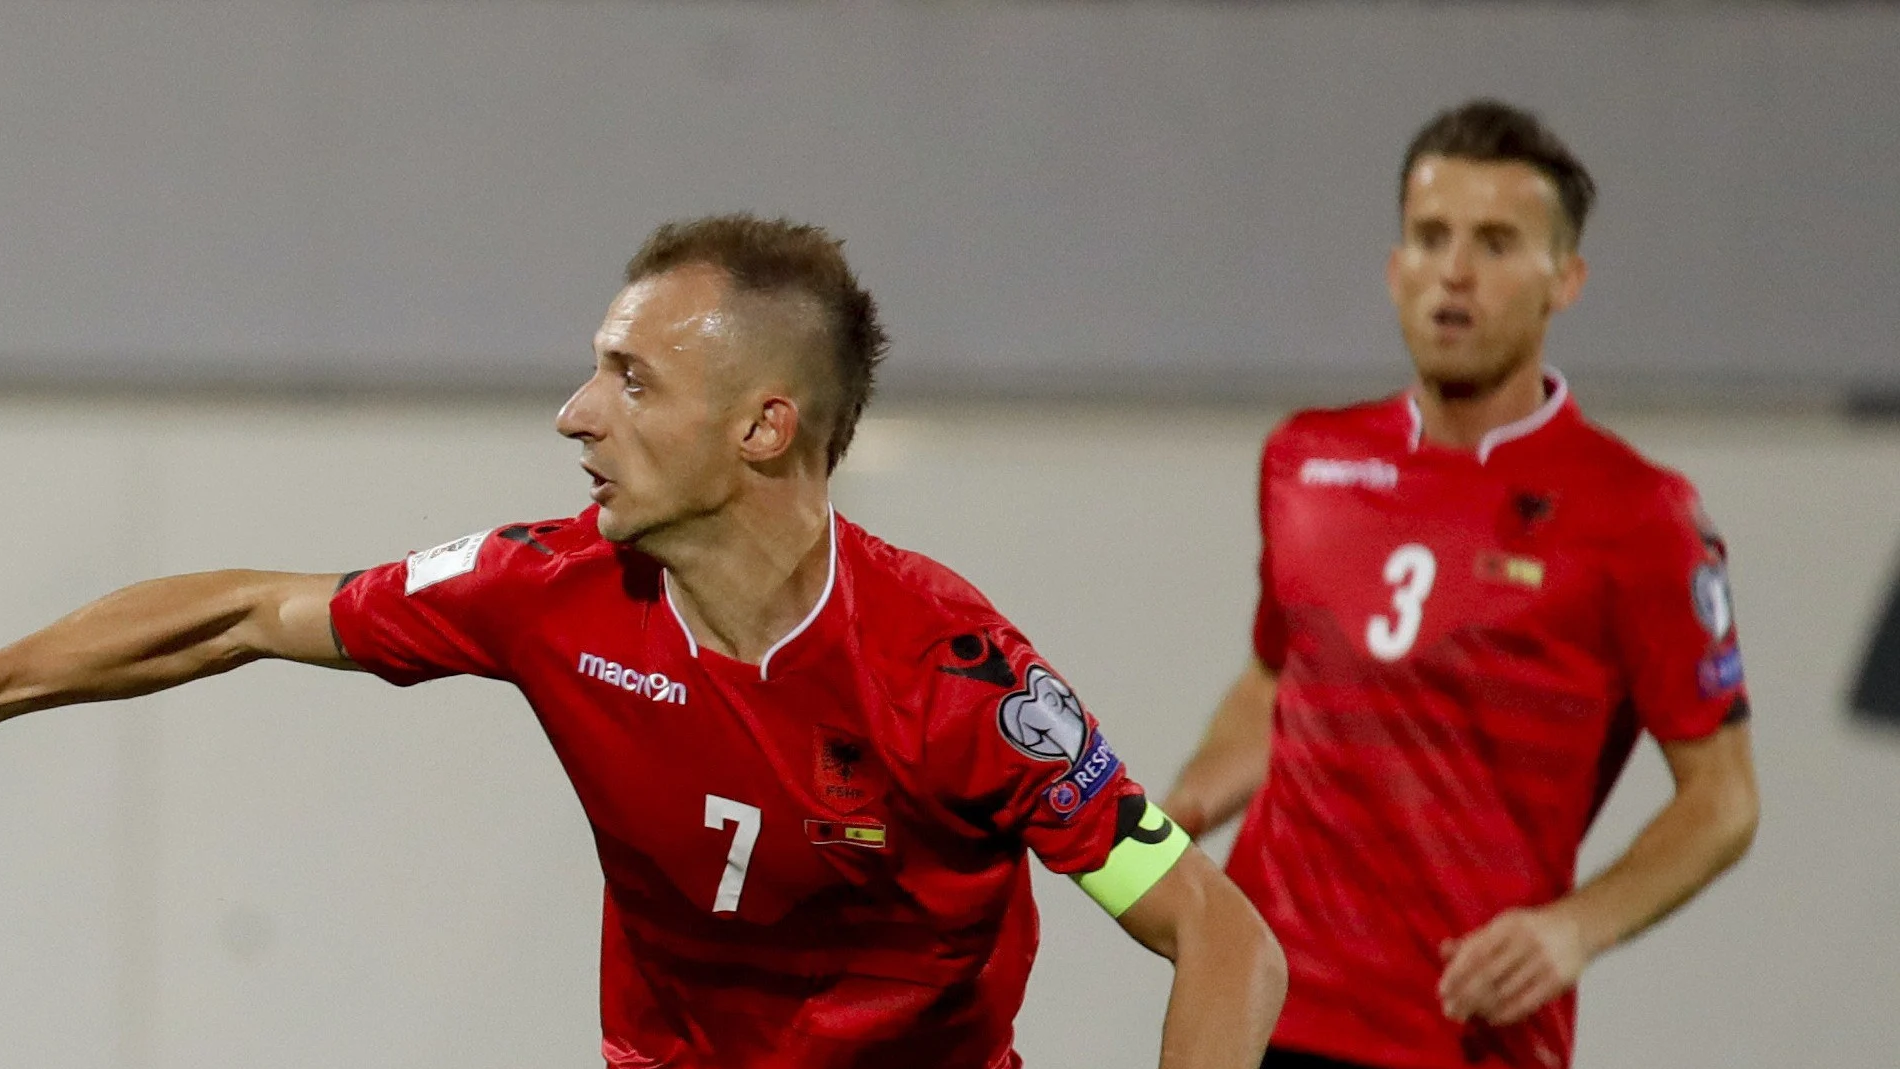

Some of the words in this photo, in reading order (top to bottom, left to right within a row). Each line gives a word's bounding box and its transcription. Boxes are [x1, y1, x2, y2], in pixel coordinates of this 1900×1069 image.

[1366, 542, 1436, 662] 3
[578, 652, 686, 705] macron
[1075, 741, 1111, 788] RESP
[704, 794, 761, 913] 7
